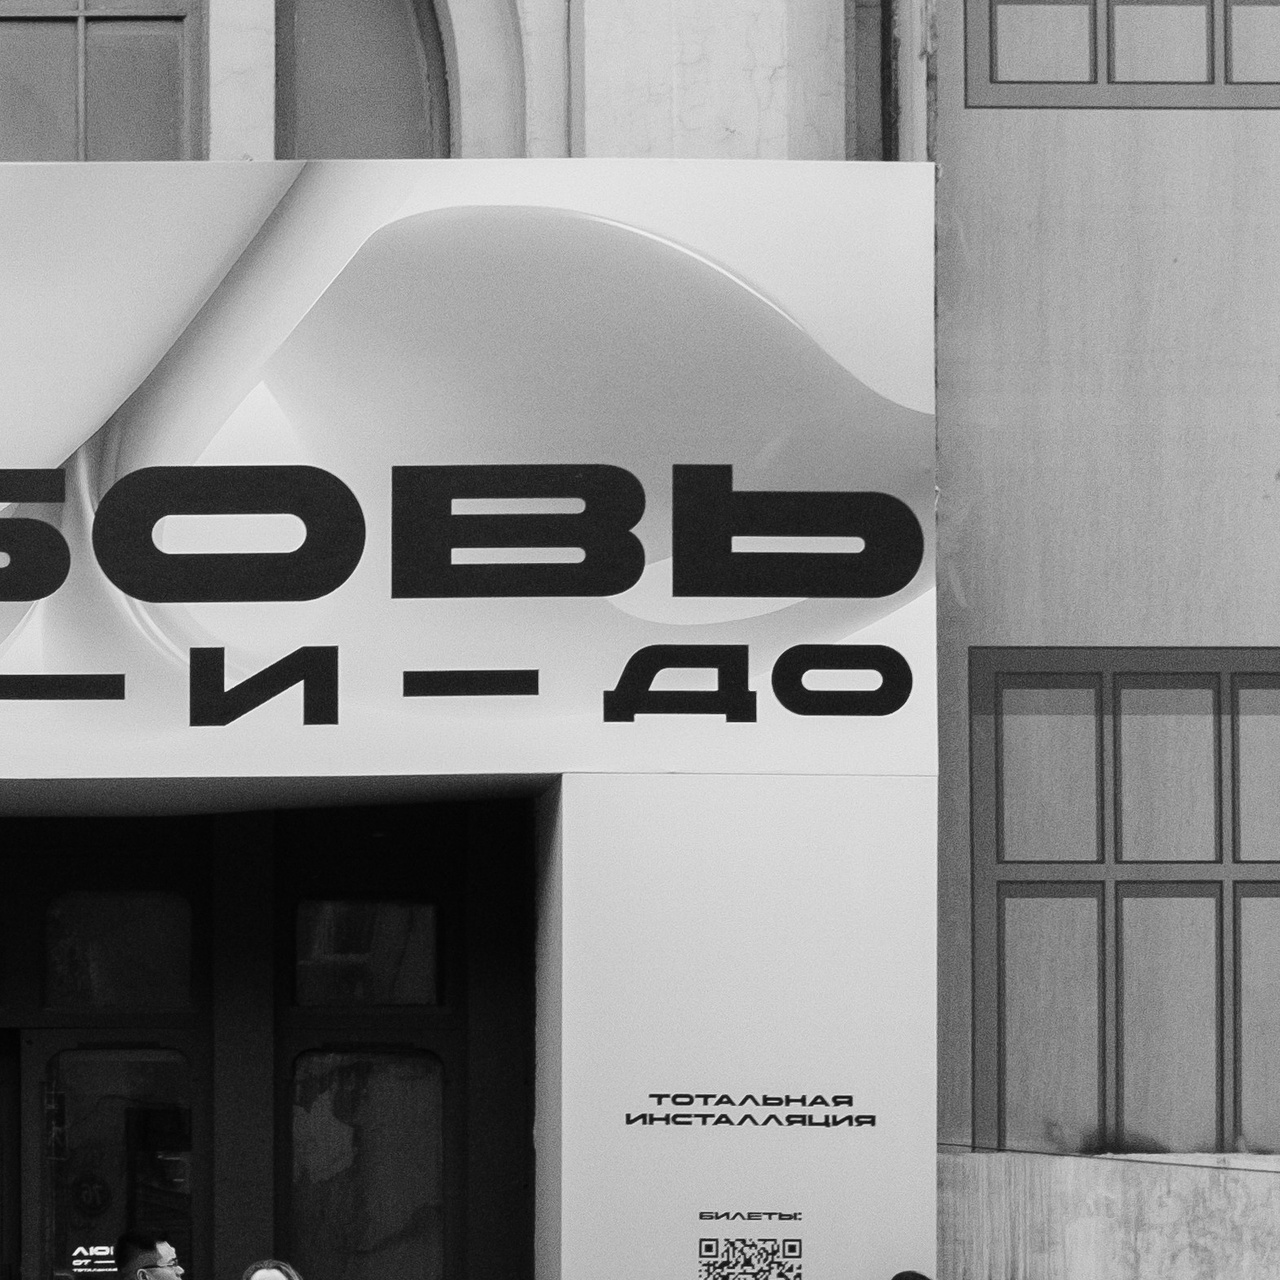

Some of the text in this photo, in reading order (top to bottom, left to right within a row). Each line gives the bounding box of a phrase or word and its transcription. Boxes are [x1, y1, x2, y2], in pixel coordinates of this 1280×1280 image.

[189, 645, 340, 727] И
[603, 644, 914, 724] ДО
[648, 1093, 854, 1107] ТОТАЛЬНАЯ
[625, 1113, 877, 1128] ИНСТАЛЛЯЦИЯ
[698, 1211, 803, 1221] БИЛЕТЫ:
[72, 1245, 114, 1257] ЛЮ
